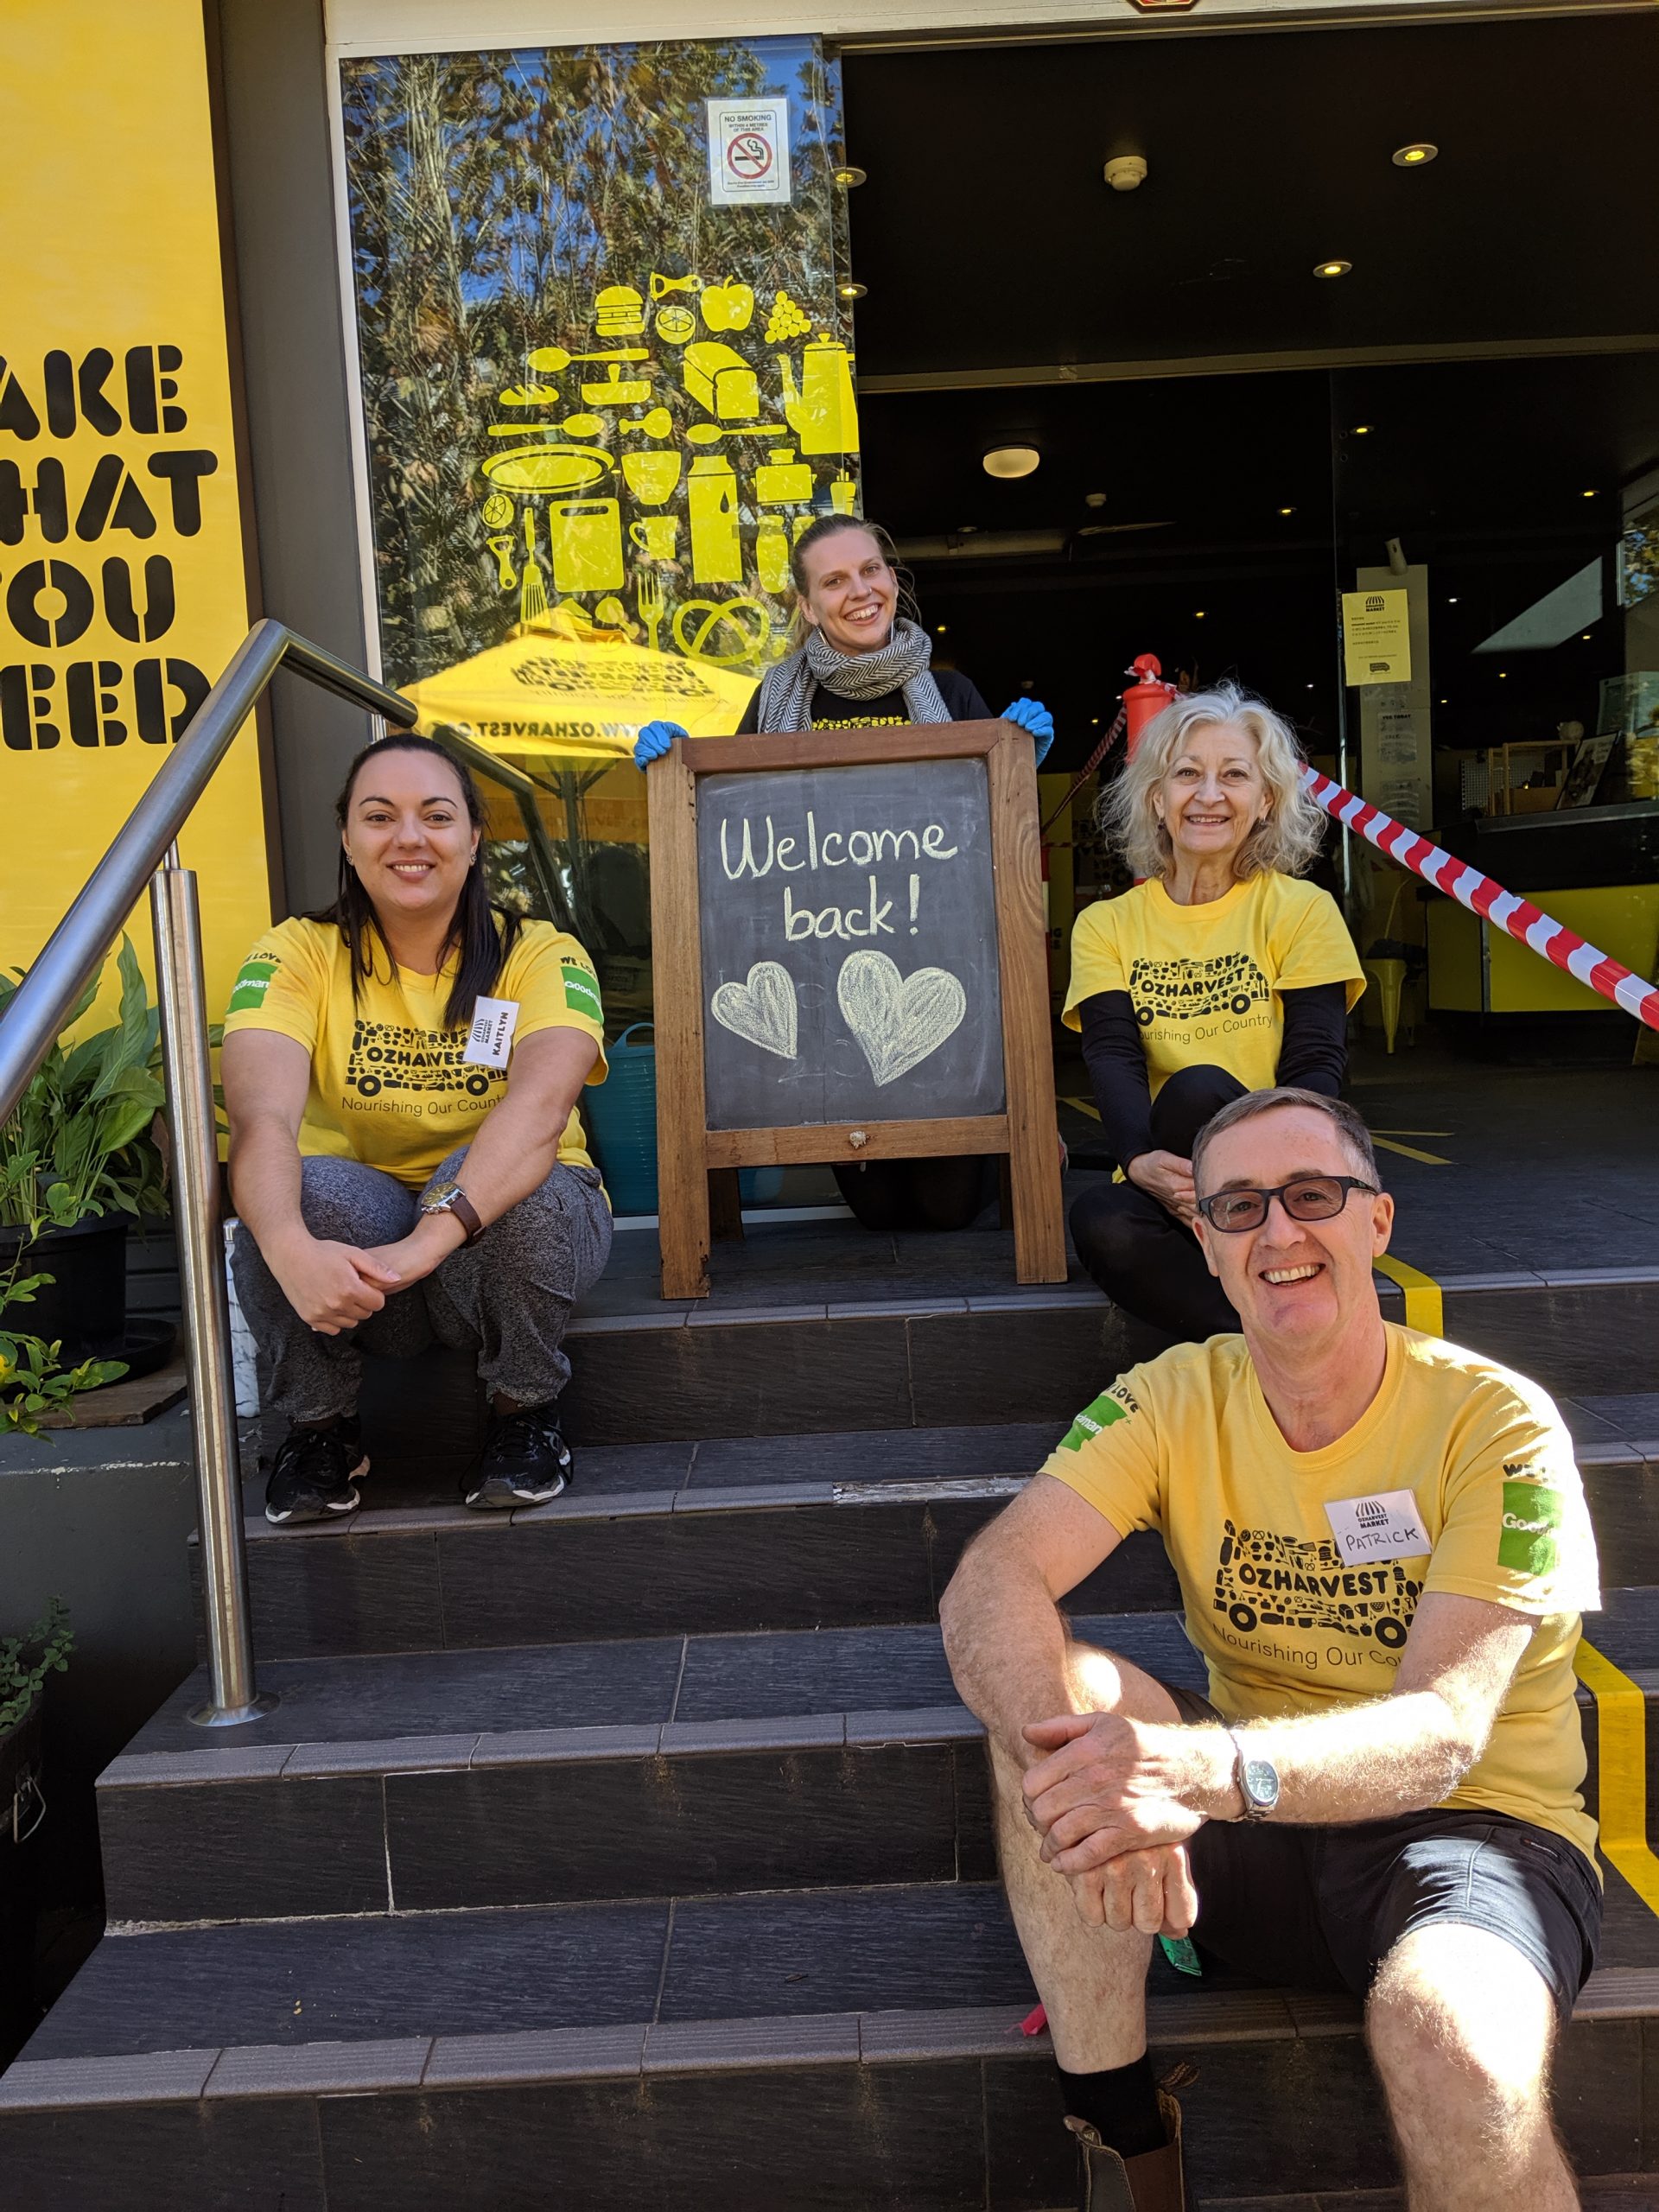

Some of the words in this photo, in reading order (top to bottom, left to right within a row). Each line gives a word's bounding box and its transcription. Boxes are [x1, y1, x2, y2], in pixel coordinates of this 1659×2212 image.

[0, 555, 175, 649] OU
[720, 810, 959, 880] Welcome
[784, 873, 920, 942] back!
[1141, 967, 1245, 998] OZHARVEST
[484, 1020, 494, 1044] MARKET
[492, 1012, 509, 1056] KAITLYN
[1140, 1028, 1191, 1045] ourishing
[1195, 1027, 1219, 1040] Our
[1223, 1014, 1273, 1034] Country
[341, 1096, 423, 1117] Nourishing
[428, 1101, 453, 1116] Our
[1357, 1513, 1388, 1522] OZHARVEST
[1360, 1518, 1389, 1529] MARKET
[1345, 1528, 1419, 1552] PATRICK
[1238, 1562, 1389, 1599] OZHARVEST
[1212, 1623, 1318, 1670] Nourishing
[1326, 1646, 1363, 1666] Our
